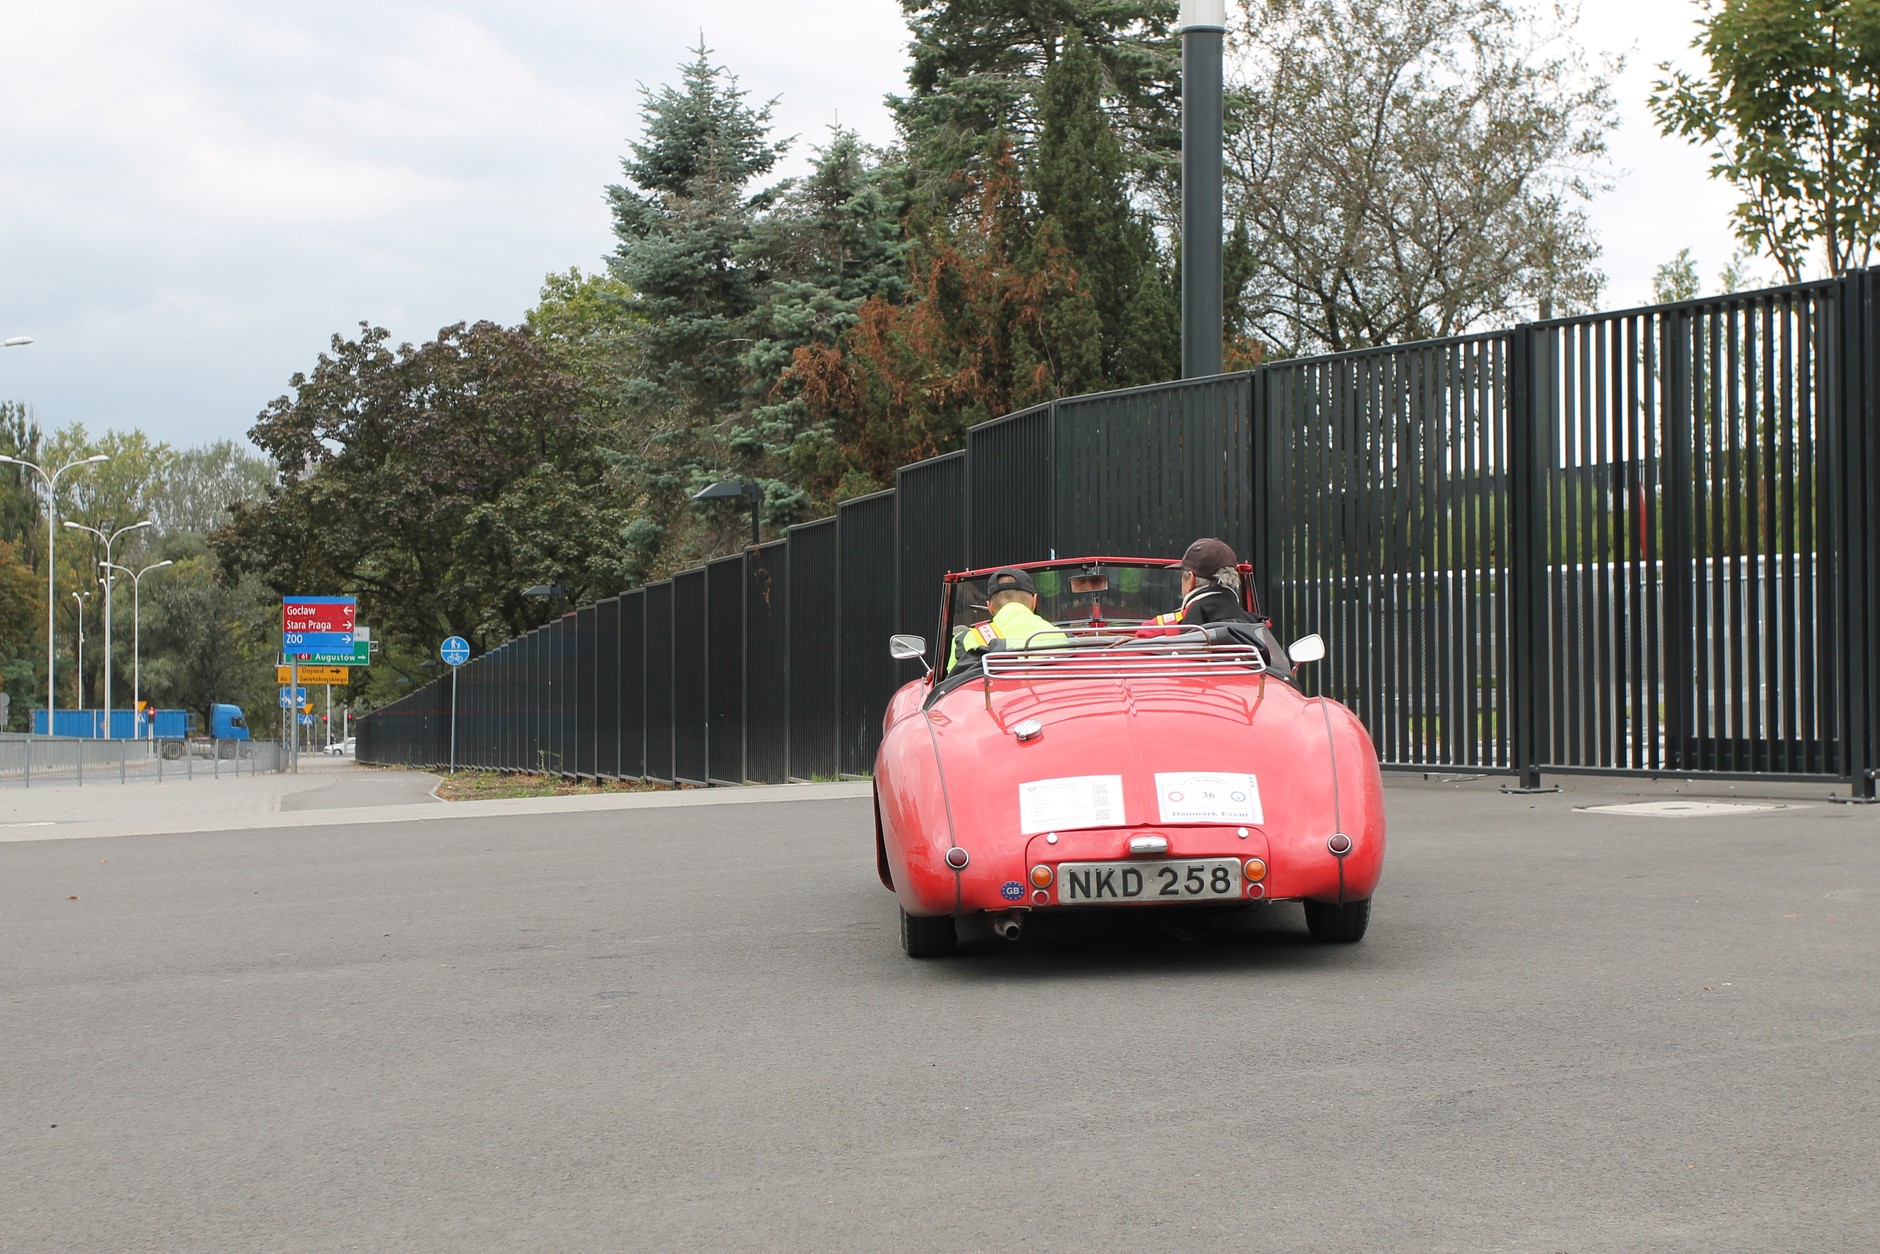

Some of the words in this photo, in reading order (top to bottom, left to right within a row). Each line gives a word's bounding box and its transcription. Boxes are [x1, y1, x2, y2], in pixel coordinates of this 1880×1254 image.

[286, 620, 306, 630] Stara
[308, 620, 332, 632] Praga
[286, 634, 303, 644] ZOO
[315, 653, 356, 663] Augustów
[1202, 791, 1216, 799] 36
[1069, 867, 1143, 899] NKD
[1157, 864, 1231, 896] 258
[1006, 886, 1020, 896] GB
